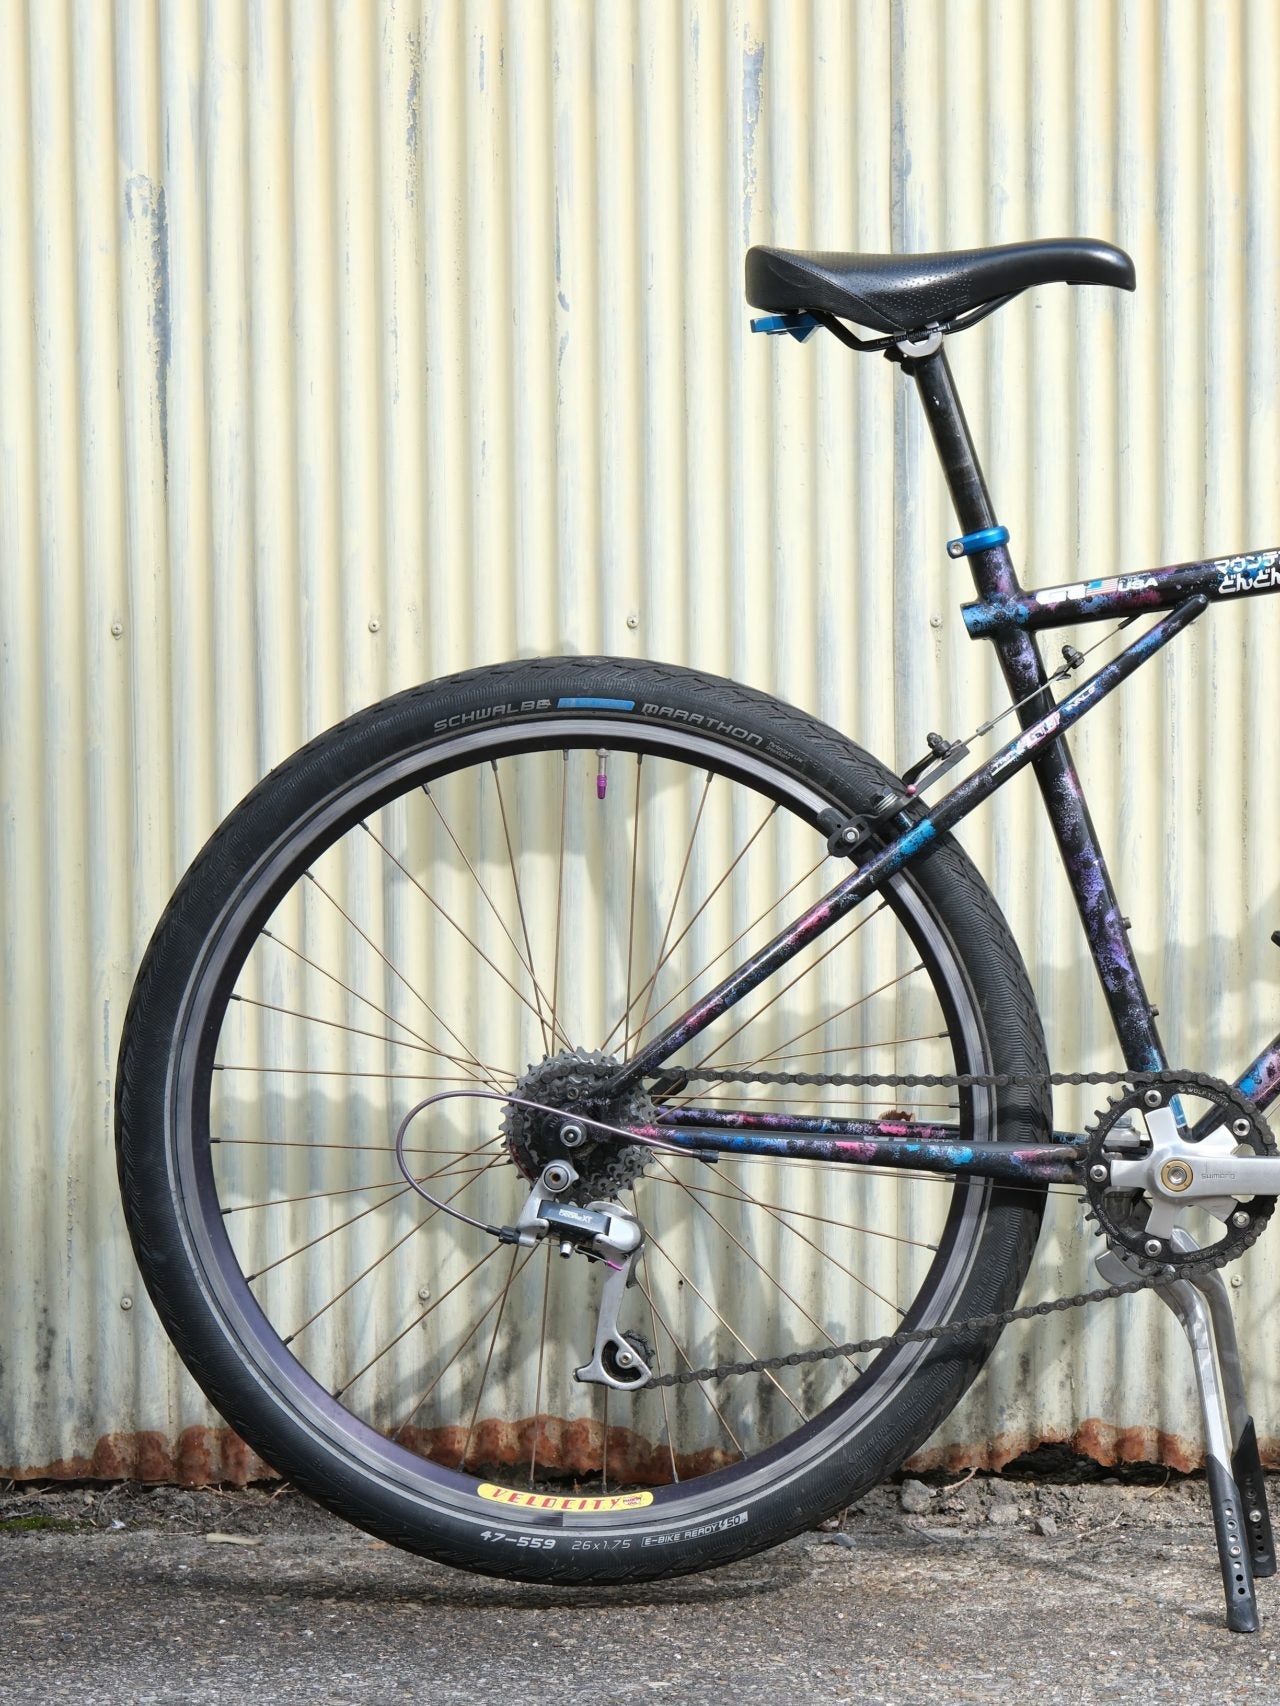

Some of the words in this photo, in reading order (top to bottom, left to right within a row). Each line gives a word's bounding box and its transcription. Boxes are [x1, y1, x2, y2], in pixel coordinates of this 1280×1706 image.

[1118, 577, 1158, 592] USA
[433, 699, 551, 733] SCHWALBE
[642, 703, 763, 746] MARATHON
[491, 1488, 622, 1510] VELOCITY
[480, 1531, 557, 1549] 47-559
[571, 1539, 632, 1551] 26x1.75
[644, 1533, 680, 1546] E-BIKE
[684, 1523, 718, 1539] READY
